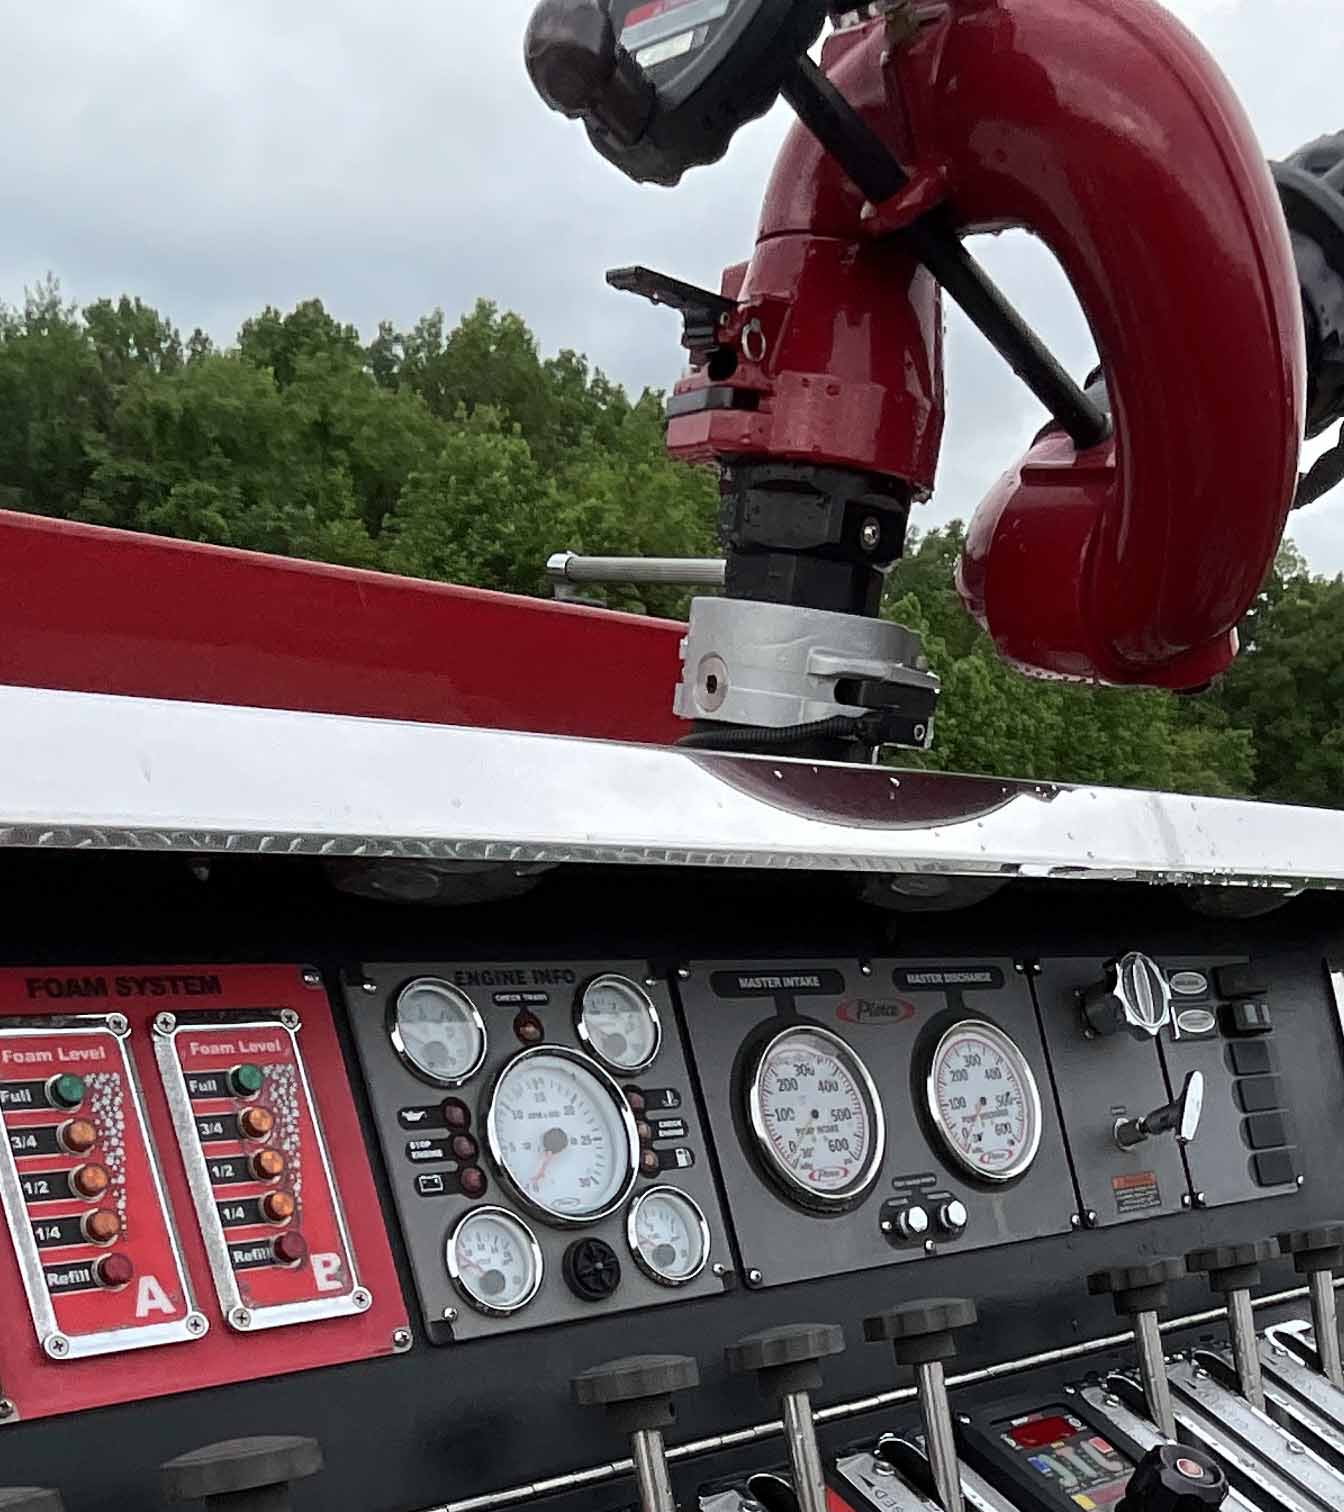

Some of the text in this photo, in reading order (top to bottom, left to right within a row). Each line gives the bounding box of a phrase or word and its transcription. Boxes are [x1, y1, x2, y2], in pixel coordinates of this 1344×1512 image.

[454, 968, 577, 987] ENGINE INFO
[738, 975, 821, 989] MASTER INTAKE
[906, 972, 993, 985] MASTER DISCHARGE
[26, 974, 223, 998] FOAM SYSTEM
[189, 1039, 282, 1055] Foam Level
[1, 1046, 106, 1064] Foam Level
[949, 1068, 969, 1082] 200
[189, 1079, 218, 1093] Full
[776, 1078, 799, 1092] 200
[817, 1079, 840, 1093] 400
[0, 1088, 33, 1104] Full
[830, 1107, 853, 1122] 500
[199, 1122, 224, 1136] 3/4
[10, 1135, 38, 1150] 3/4
[827, 1137, 850, 1152] 600
[211, 1164, 235, 1178] 1/2
[23, 1180, 50, 1196] 1/2
[222, 1206, 245, 1222] 1/4
[34, 1226, 62, 1241] 1/4
[232, 1247, 272, 1264] Refill
[47, 1268, 91, 1287] Refill
[135, 1275, 177, 1318] A
